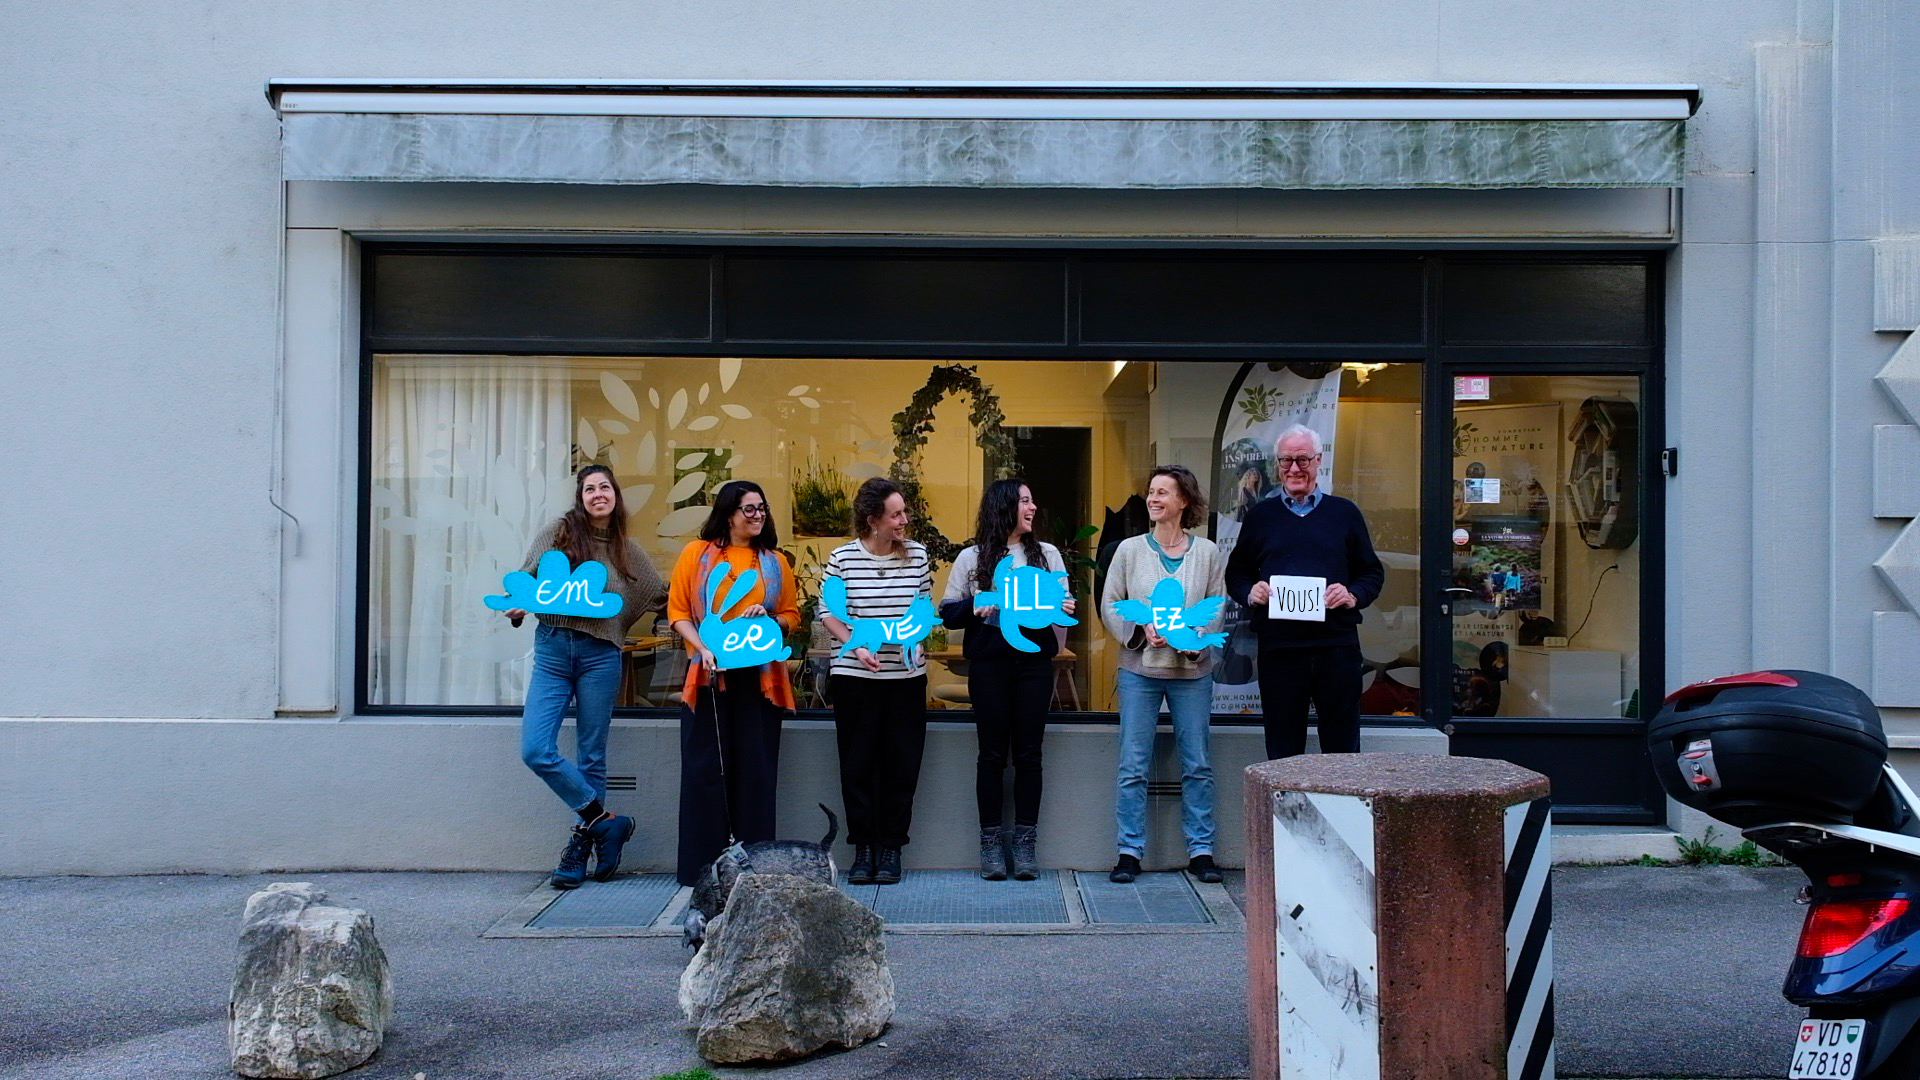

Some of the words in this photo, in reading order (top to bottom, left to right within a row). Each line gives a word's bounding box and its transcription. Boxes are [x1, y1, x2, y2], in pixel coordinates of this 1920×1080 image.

[1473, 434, 1519, 443] HOMME
[1473, 445, 1486, 453] ET
[1492, 443, 1544, 452] NATURE
[1225, 452, 1268, 463] INSPIRER
[1152, 607, 1185, 631] EZ
[1818, 1022, 1843, 1047] VD
[1793, 1051, 1853, 1076] 47818
